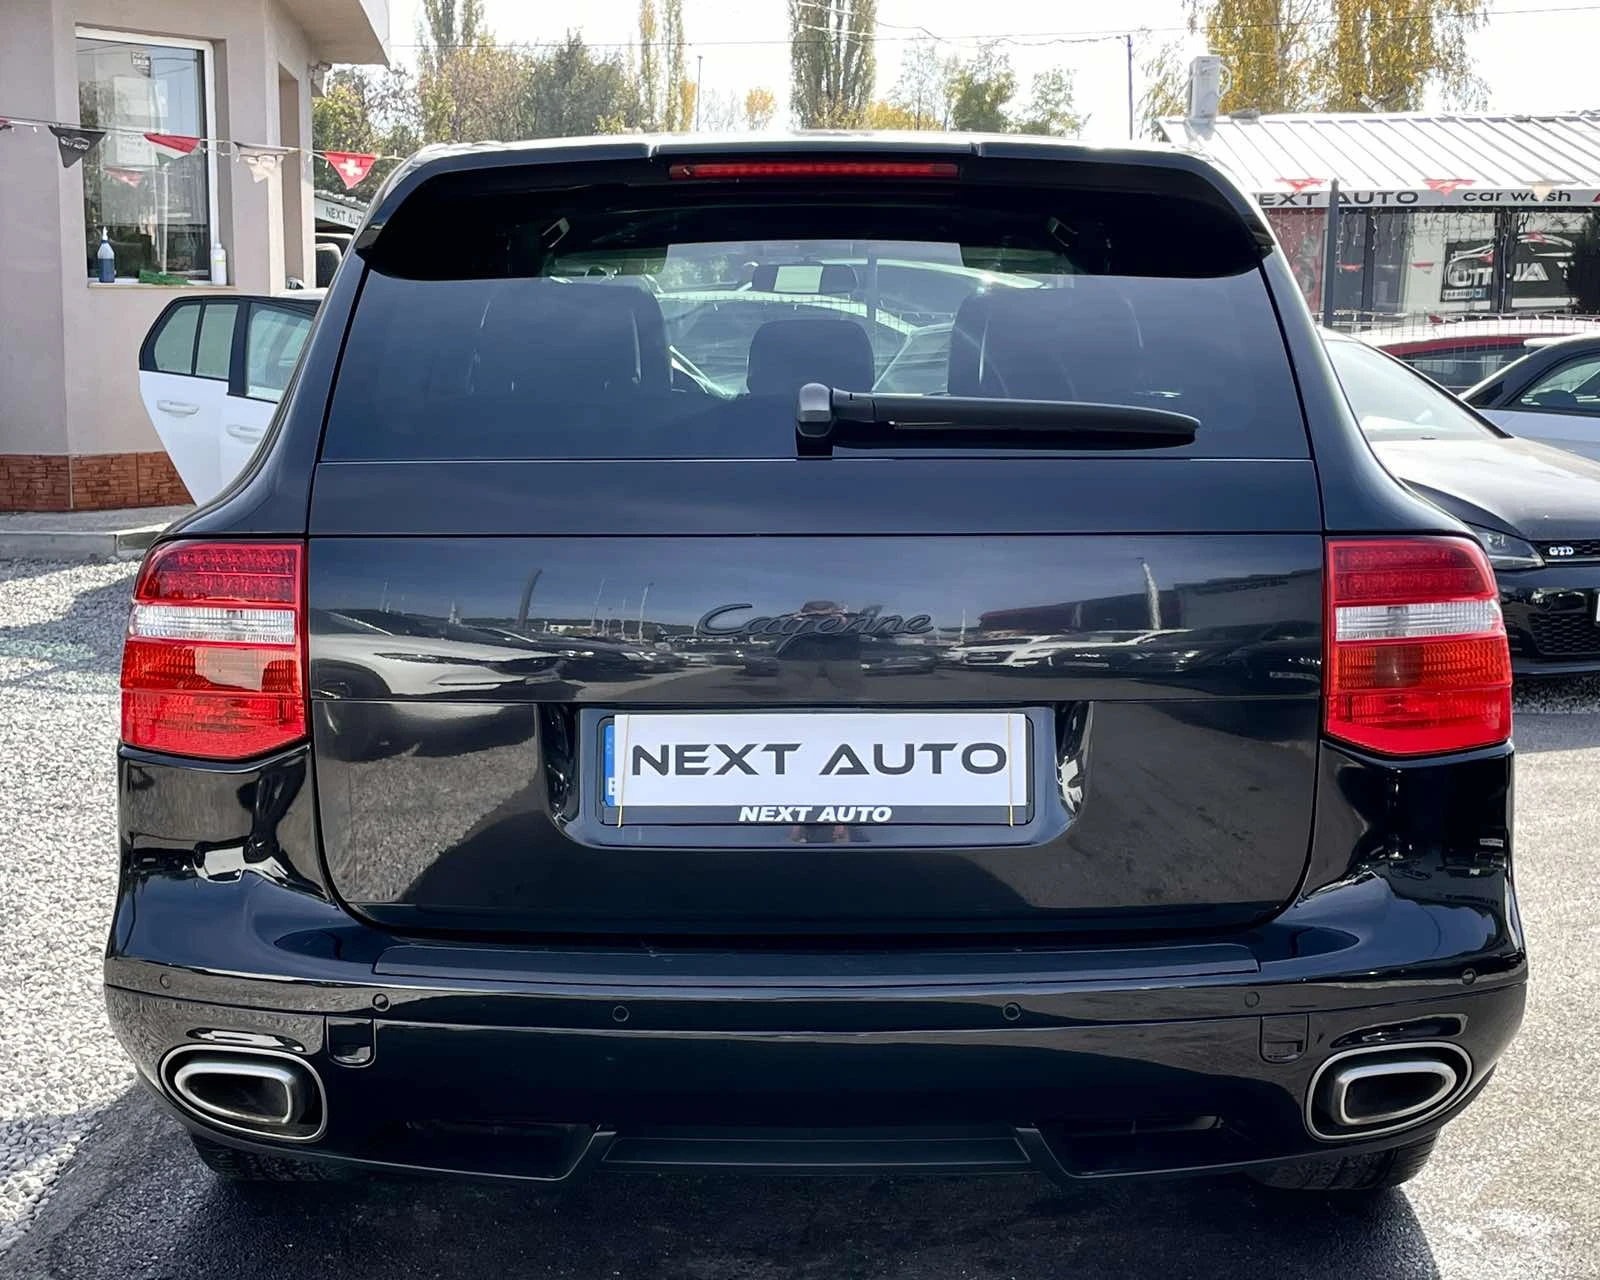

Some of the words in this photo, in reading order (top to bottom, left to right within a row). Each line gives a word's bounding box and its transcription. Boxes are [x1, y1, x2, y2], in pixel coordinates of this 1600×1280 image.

[1463, 192, 1503, 202] car
[325, 205, 346, 221] NEXT
[1549, 546, 1574, 556] GTD
[698, 603, 934, 659] Cayenne
[632, 743, 802, 776] NEXT
[818, 742, 1007, 775] AUTO
[738, 806, 817, 823] NEXT
[817, 806, 892, 823] AUTO
